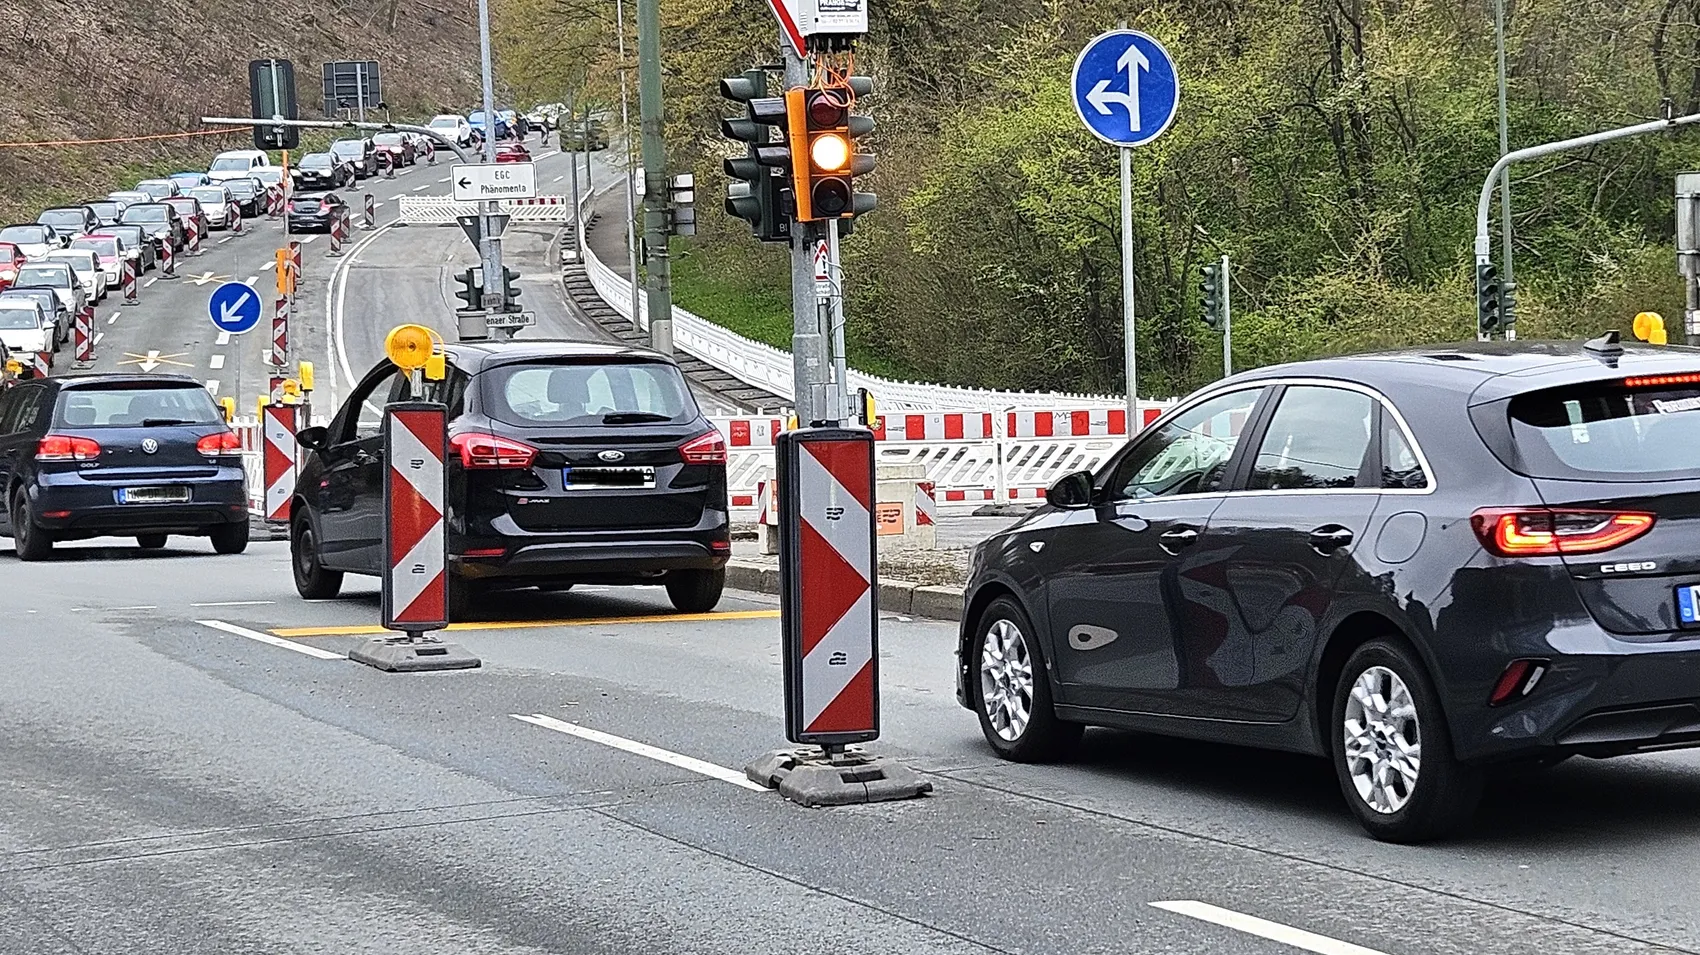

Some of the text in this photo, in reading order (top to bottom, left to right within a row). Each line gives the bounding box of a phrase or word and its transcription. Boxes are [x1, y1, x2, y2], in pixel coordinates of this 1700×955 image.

[494, 170, 511, 180] EGC
[480, 184, 527, 194] Phänomenta
[508, 314, 530, 323] Straße
